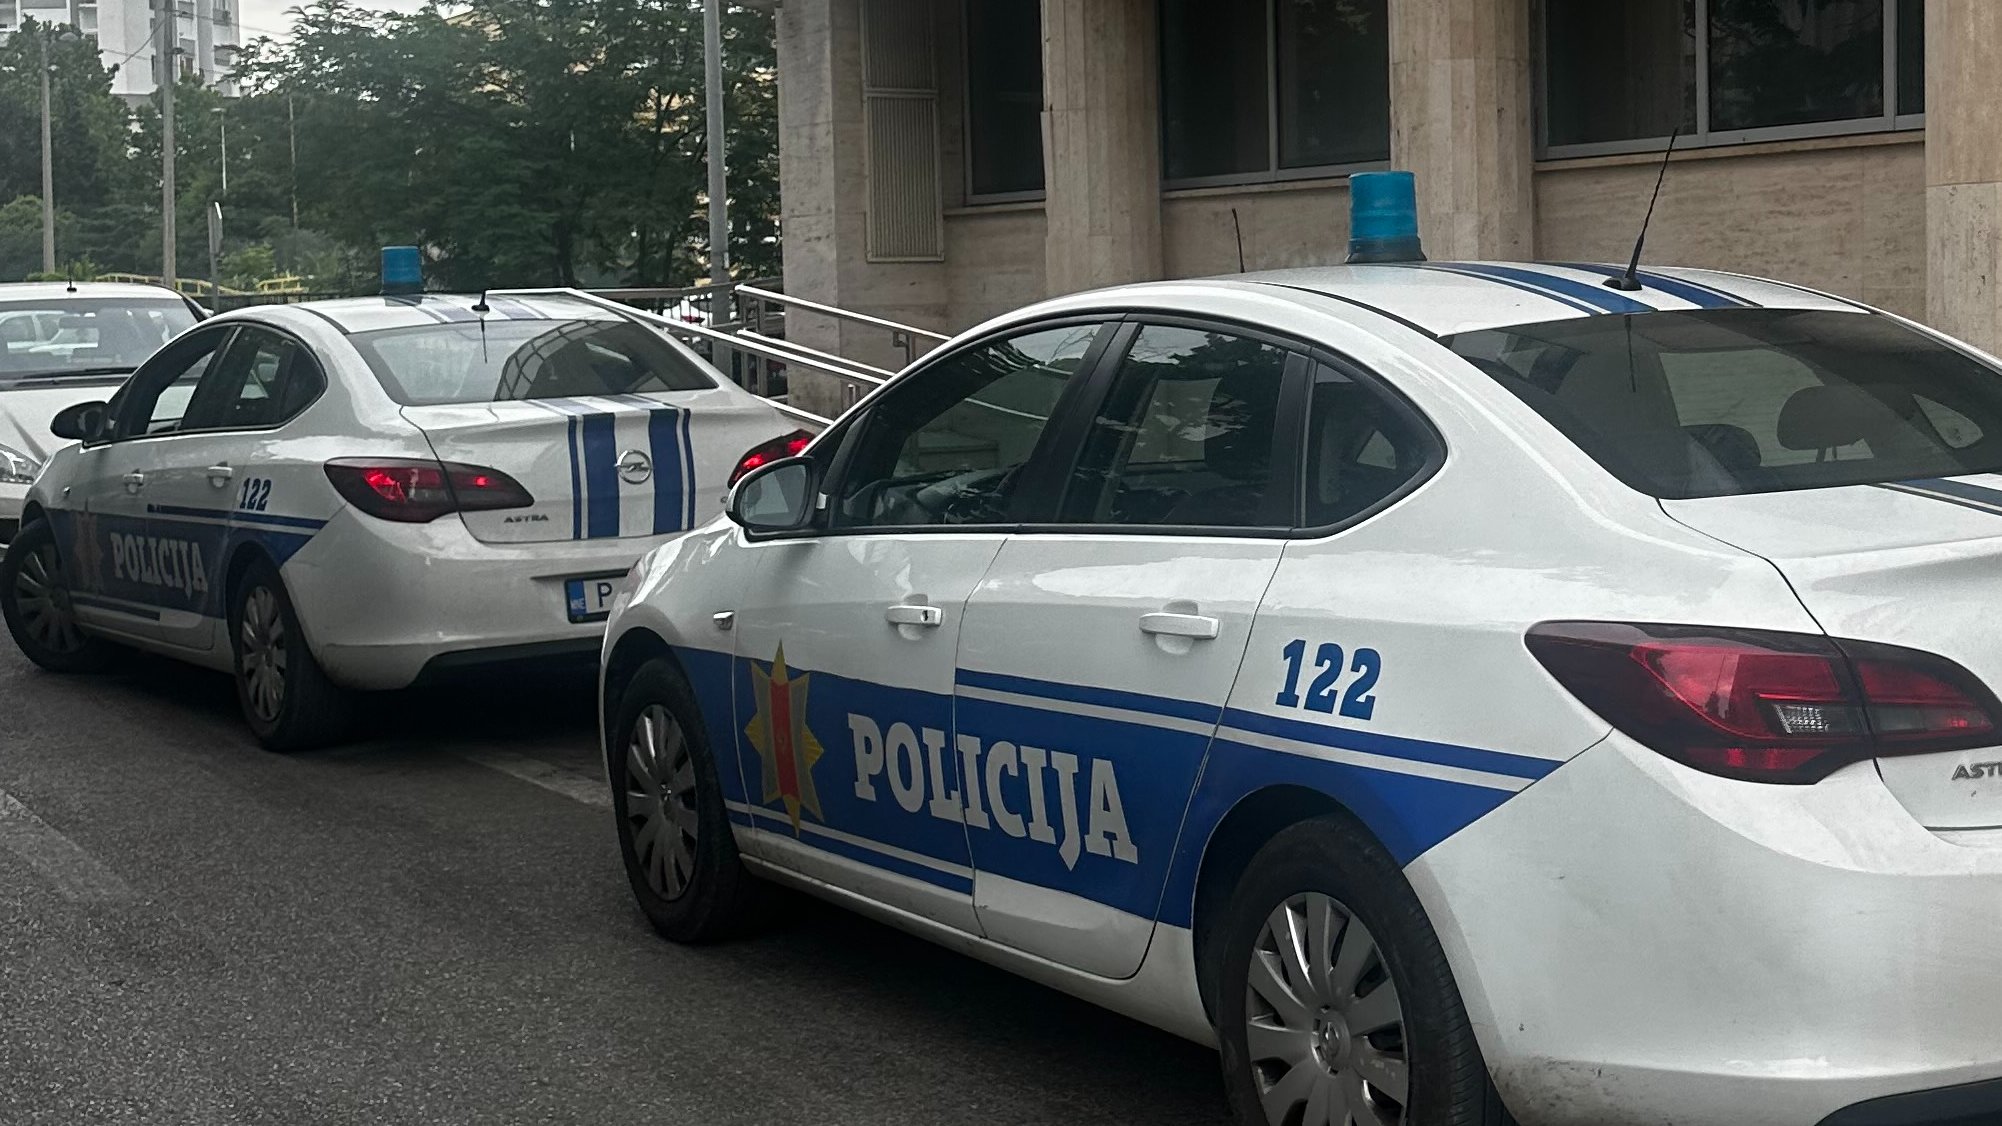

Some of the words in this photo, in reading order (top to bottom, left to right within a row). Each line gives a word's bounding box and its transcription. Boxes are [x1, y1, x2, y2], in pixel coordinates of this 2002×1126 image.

[239, 477, 272, 511] 122
[503, 514, 549, 523] ASTRA
[110, 532, 208, 600] POLICIJA
[1275, 639, 1381, 720] 122
[847, 712, 1138, 871] POLICIJA
